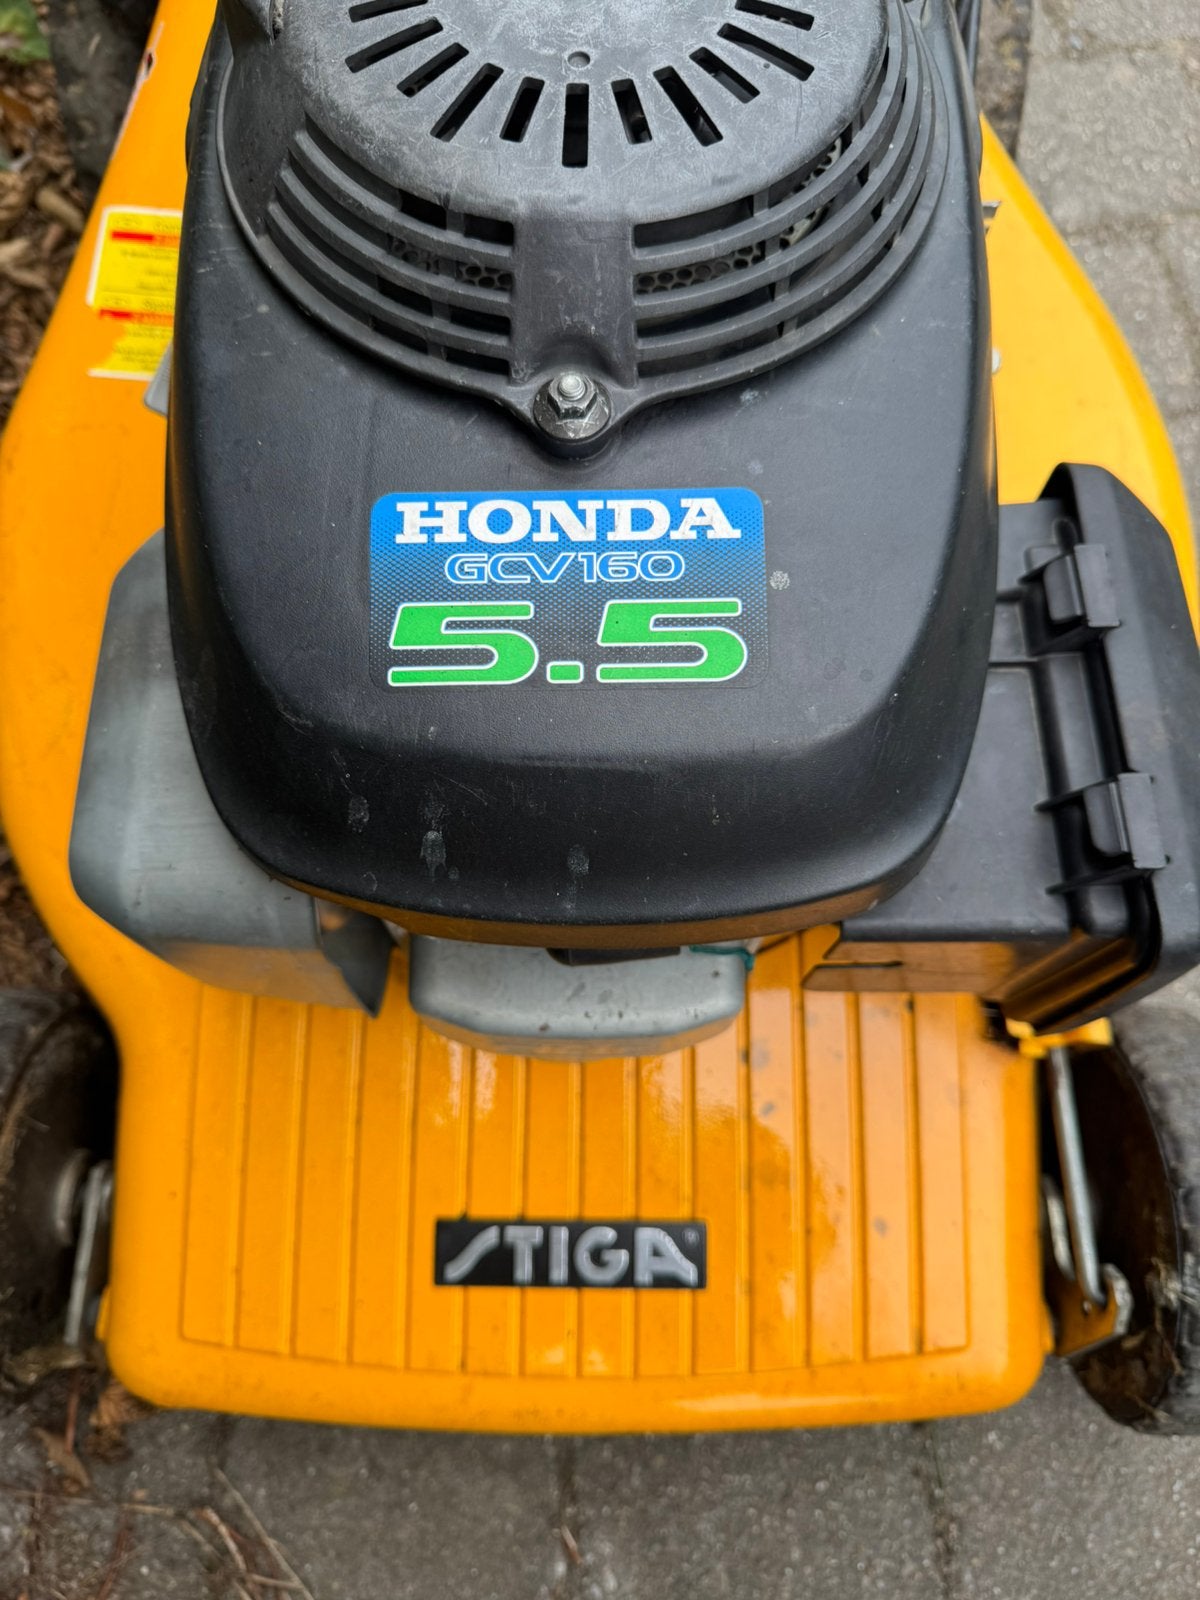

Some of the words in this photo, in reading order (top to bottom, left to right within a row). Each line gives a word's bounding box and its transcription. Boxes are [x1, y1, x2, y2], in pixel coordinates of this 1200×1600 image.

[395, 497, 741, 544] HONDA
[445, 550, 685, 584] GCV160
[387, 597, 748, 686] 5.5
[443, 1224, 699, 1287] STIGA
